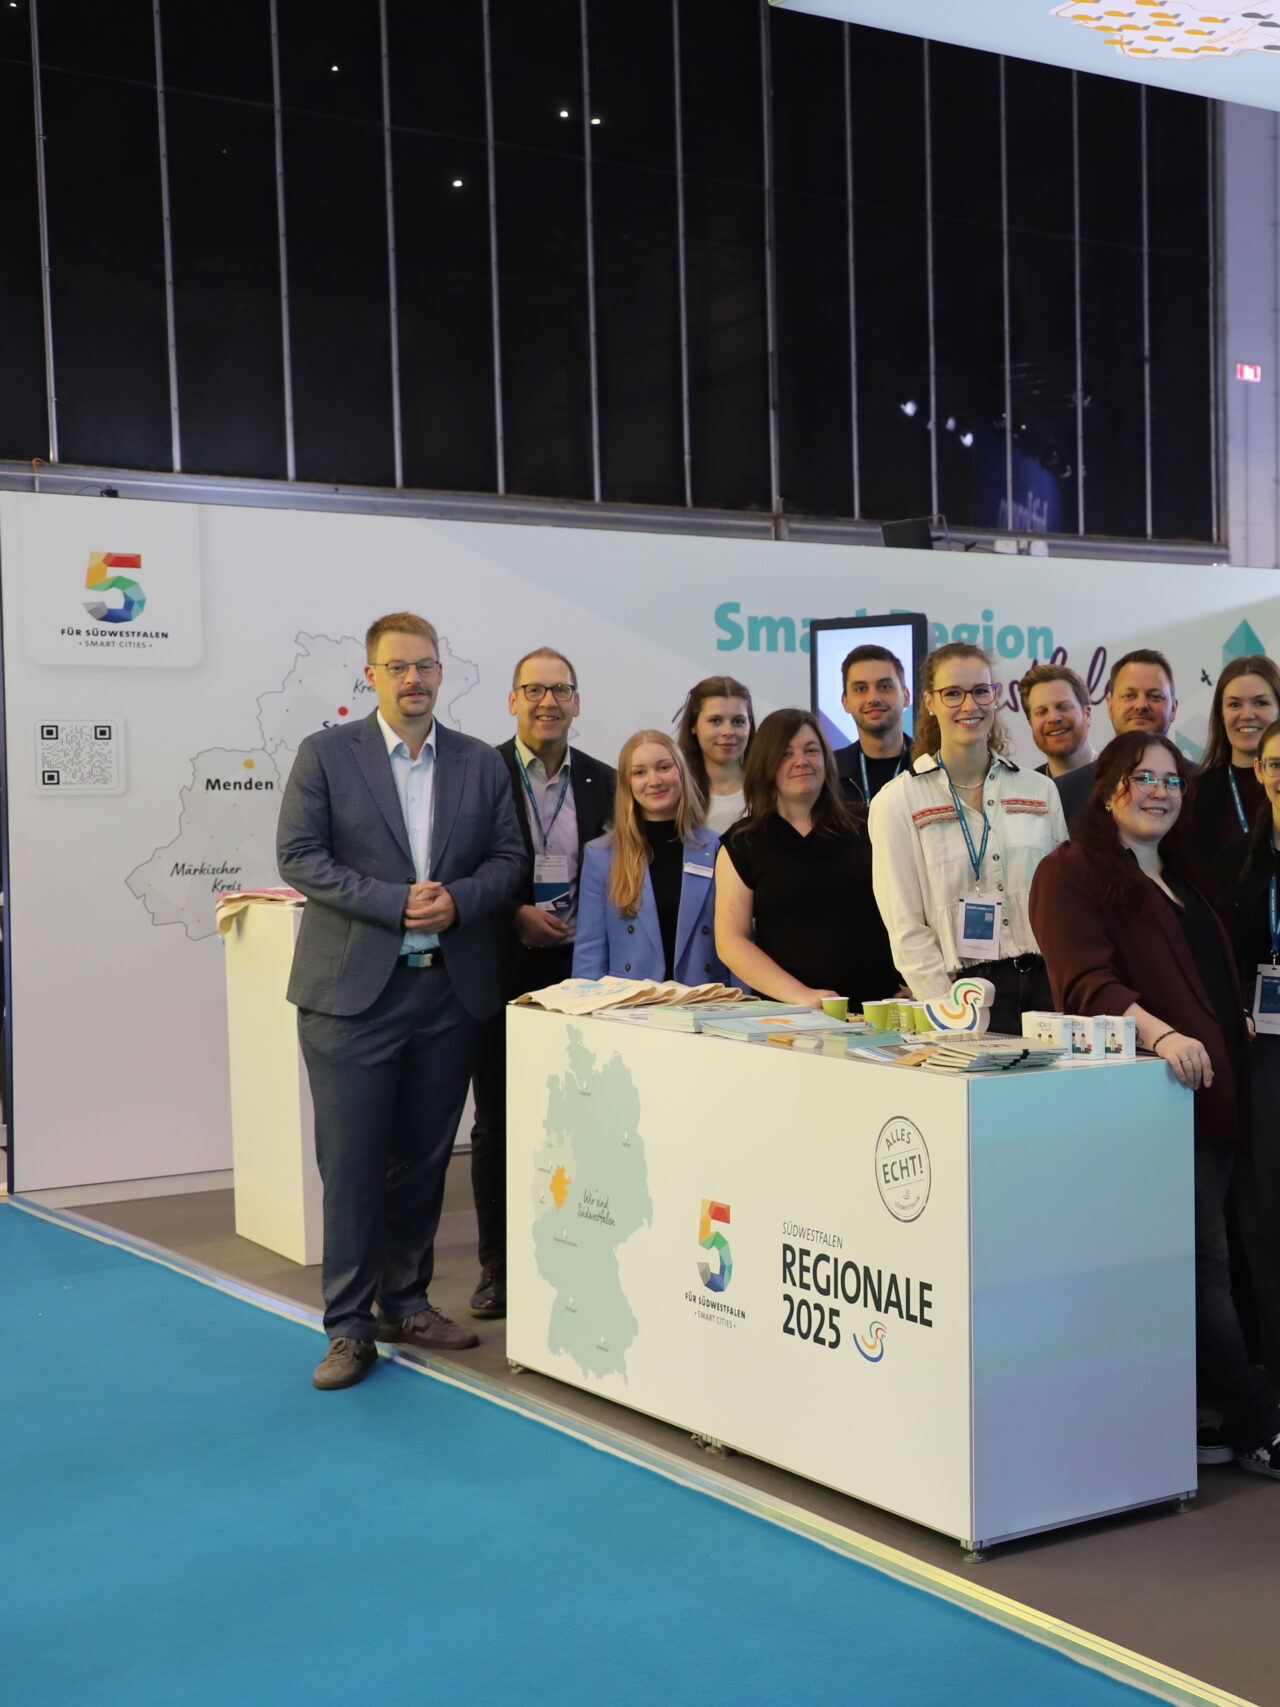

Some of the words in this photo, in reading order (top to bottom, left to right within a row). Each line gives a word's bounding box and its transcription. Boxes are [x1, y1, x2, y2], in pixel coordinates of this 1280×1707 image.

[61, 627, 82, 637] FÜR
[86, 628, 169, 639] SÜDWESTFALEN
[85, 640, 115, 648] SMART
[119, 641, 147, 649] CITIES
[205, 778, 274, 791] Menden
[170, 860, 242, 877] Märkischer
[211, 877, 242, 892] Kreis
[885, 1128, 911, 1151] ALLES
[882, 1154, 923, 1184] ECHT!
[782, 1220, 844, 1249] SÜDWESTFALEN
[782, 1242, 933, 1328] REGIONALE
[685, 1290, 697, 1303] FÜR
[698, 1295, 746, 1319] SÜDWESTFALEN
[697, 1310, 715, 1323] SMART
[716, 1316, 733, 1328] CITIES
[782, 1293, 841, 1350] 2025
